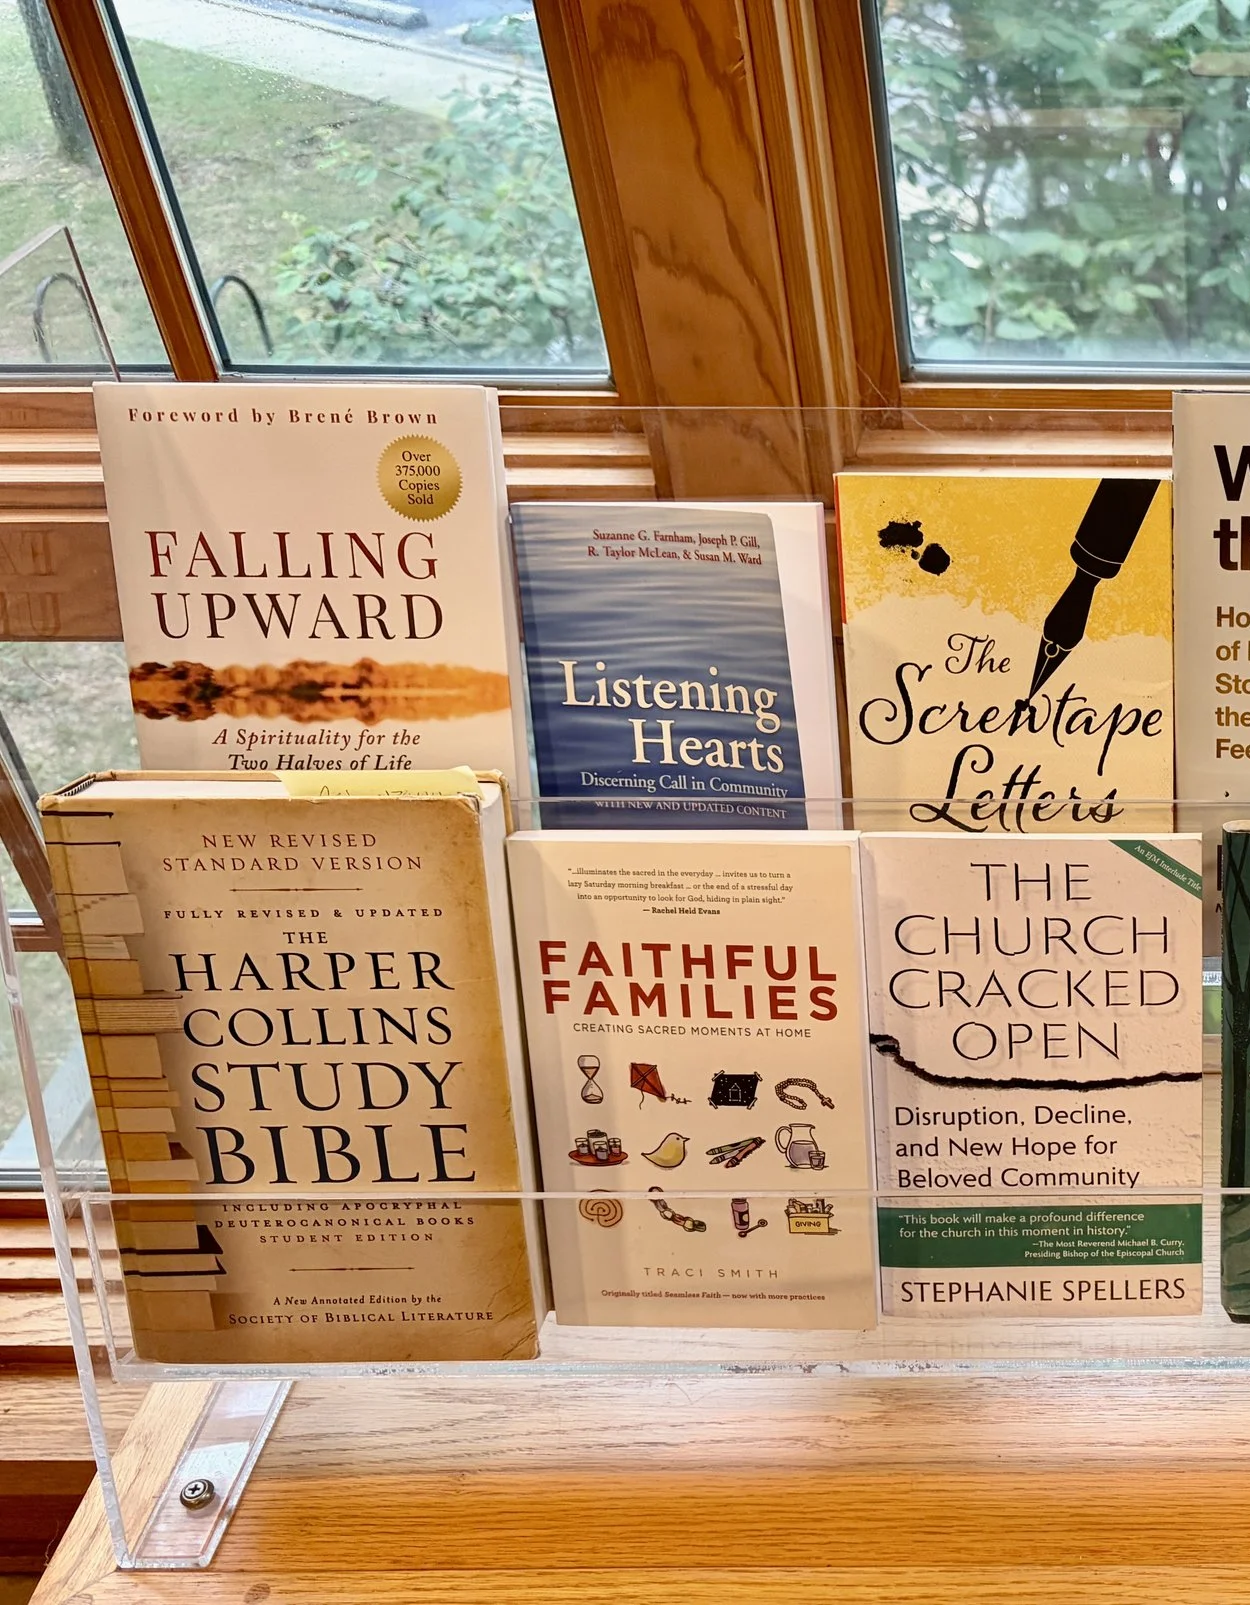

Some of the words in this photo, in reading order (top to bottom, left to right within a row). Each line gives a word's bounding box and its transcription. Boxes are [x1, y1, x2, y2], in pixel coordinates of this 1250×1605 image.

[129, 408, 239, 423] Foreword
[252, 409, 276, 424] by
[289, 408, 354, 423] Brené
[367, 410, 438, 424] Brown
[402, 451, 431, 462] Over
[395, 465, 440, 477] 375,000
[399, 480, 440, 493] Copies
[408, 494, 434, 505] Sold
[593, 529, 635, 541] Suzanne
[638, 530, 650, 541] G.
[145, 531, 439, 579] FALLING
[588, 545, 600, 556] R.
[603, 546, 635, 560] Taylor
[683, 550, 691, 560] &
[694, 551, 720, 562] Susan
[723, 552, 736, 563] M.
[738, 553, 762, 565] Ward
[150, 593, 443, 639] UPWARD
[945, 633, 1010, 674] The
[559, 661, 781, 734] Listening
[860, 662, 1162, 776] Screwtape
[212, 729, 228, 745] A
[236, 729, 351, 750] Spirituality
[358, 729, 387, 750] for
[392, 730, 421, 745] the
[628, 719, 785, 773] Hearts
[581, 771, 656, 792] Discerning
[660, 775, 686, 789] Call
[692, 778, 705, 790] in
[709, 778, 789, 797] Community
[910, 744, 1124, 832] Letters
[202, 834, 256, 848] NEW
[270, 833, 378, 848] REVISED
[163, 857, 299, 872] STANDARD
[312, 856, 424, 870] VERSION
[970, 862, 1092, 901] THE
[163, 909, 224, 919] FULLY
[237, 909, 320, 918] REVISED
[334, 909, 342, 918] &
[355, 908, 444, 918] UPDATED
[283, 932, 328, 944] THE
[895, 915, 1169, 956] CHURCH
[168, 952, 455, 992] HARPER
[539, 941, 837, 981] FAITHFUL
[543, 980, 838, 1021] FAMILIES
[889, 969, 1180, 1009] CRACKED
[183, 1006, 452, 1047] COLLINS
[573, 1023, 633, 1034] CREATING
[638, 1025, 686, 1035] SACRED
[691, 1027, 751, 1036] MOMENTS
[756, 1027, 771, 1037] AT
[775, 1028, 812, 1038] HOME
[953, 1022, 1120, 1060] OPEN
[191, 1061, 463, 1112] STUDY
[895, 1107, 1025, 1130] Disruption,
[1035, 1105, 1132, 1125] Decline,
[195, 1124, 476, 1184] BIBLE
[896, 1137, 939, 1156] and
[949, 1138, 1003, 1156] New
[1012, 1137, 1076, 1160] Hope
[1085, 1135, 1118, 1154] for
[899, 1168, 992, 1188] Beloved
[1001, 1167, 1140, 1189] Community
[222, 1203, 329, 1212] INCLUDING
[341, 1201, 462, 1211] APOCRYPHAL
[930, 1214, 960, 1223] book
[963, 1214, 982, 1223] will
[985, 1213, 1016, 1223] make
[1029, 1212, 1083, 1224] profound
[1086, 1211, 1145, 1222] difference
[214, 1217, 406, 1228] DEUTEROCANONICAL
[416, 1217, 476, 1226] BOOKS
[643, 1267, 703, 1277] TRACI
[718, 1268, 778, 1279] SMITH
[901, 1280, 1052, 1302] STEPHANIE
[1062, 1278, 1186, 1300] SPELLERS
[229, 1313, 294, 1324] SOCIETY
[300, 1313, 318, 1323] OF
[326, 1312, 395, 1322] BIBLICAL
[401, 1310, 494, 1322] LITERATURE
